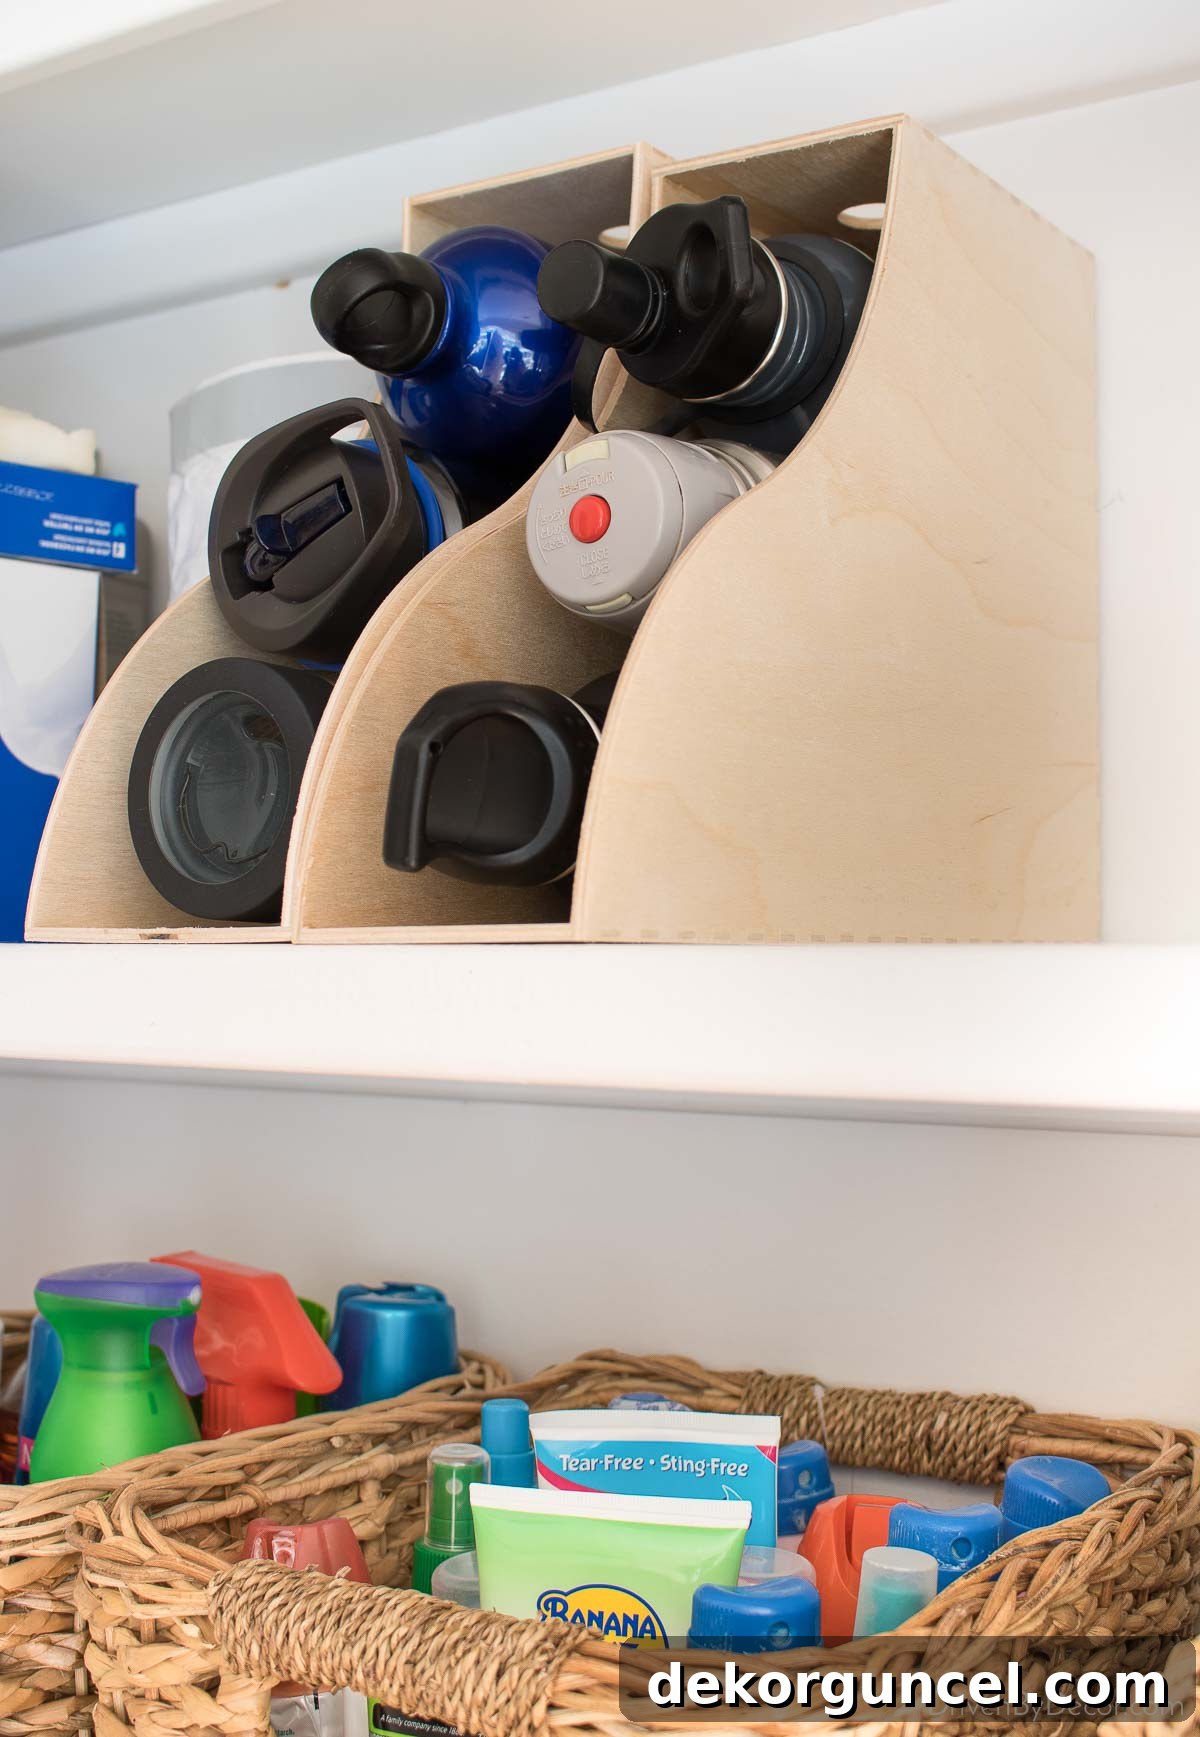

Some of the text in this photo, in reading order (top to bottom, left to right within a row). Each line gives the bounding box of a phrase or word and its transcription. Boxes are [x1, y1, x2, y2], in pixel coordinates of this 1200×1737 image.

[581, 549, 609, 565] CLOSE
[559, 1454, 749, 1478] Tear-Free Sting-Free
[386, 1716, 404, 1727] family
[403, 1720, 431, 1732] company
[432, 1725, 448, 1734] since
